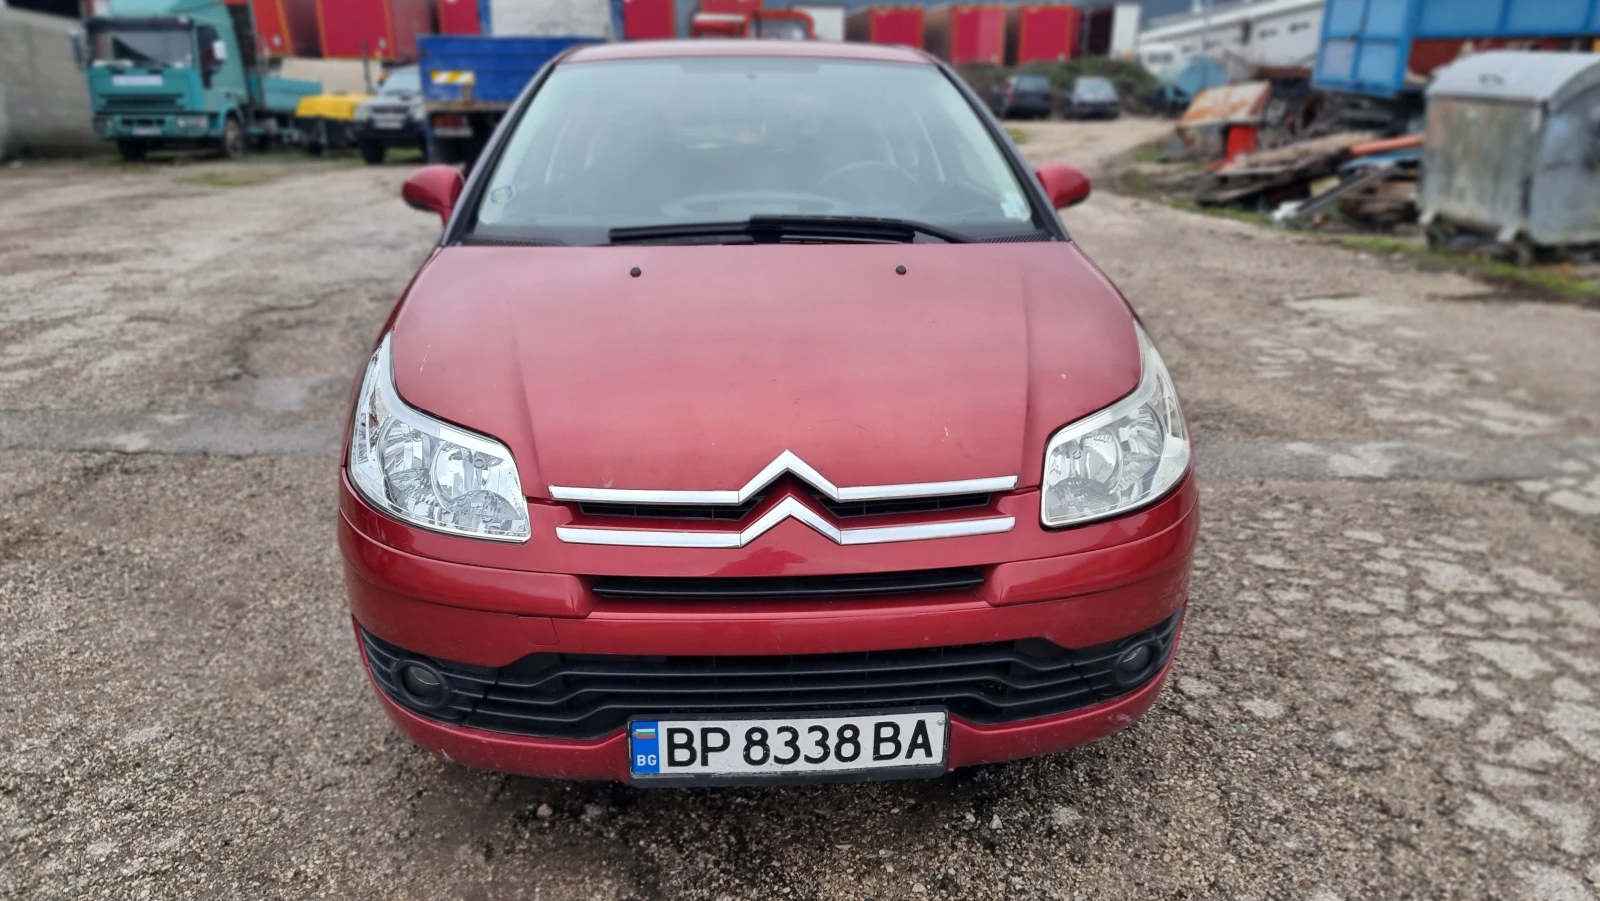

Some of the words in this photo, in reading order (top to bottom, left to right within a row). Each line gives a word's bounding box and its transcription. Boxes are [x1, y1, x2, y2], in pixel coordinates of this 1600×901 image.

[666, 727, 730, 767] BP
[742, 723, 862, 766] 8338
[872, 719, 933, 761] BA
[636, 754, 657, 766] BG
